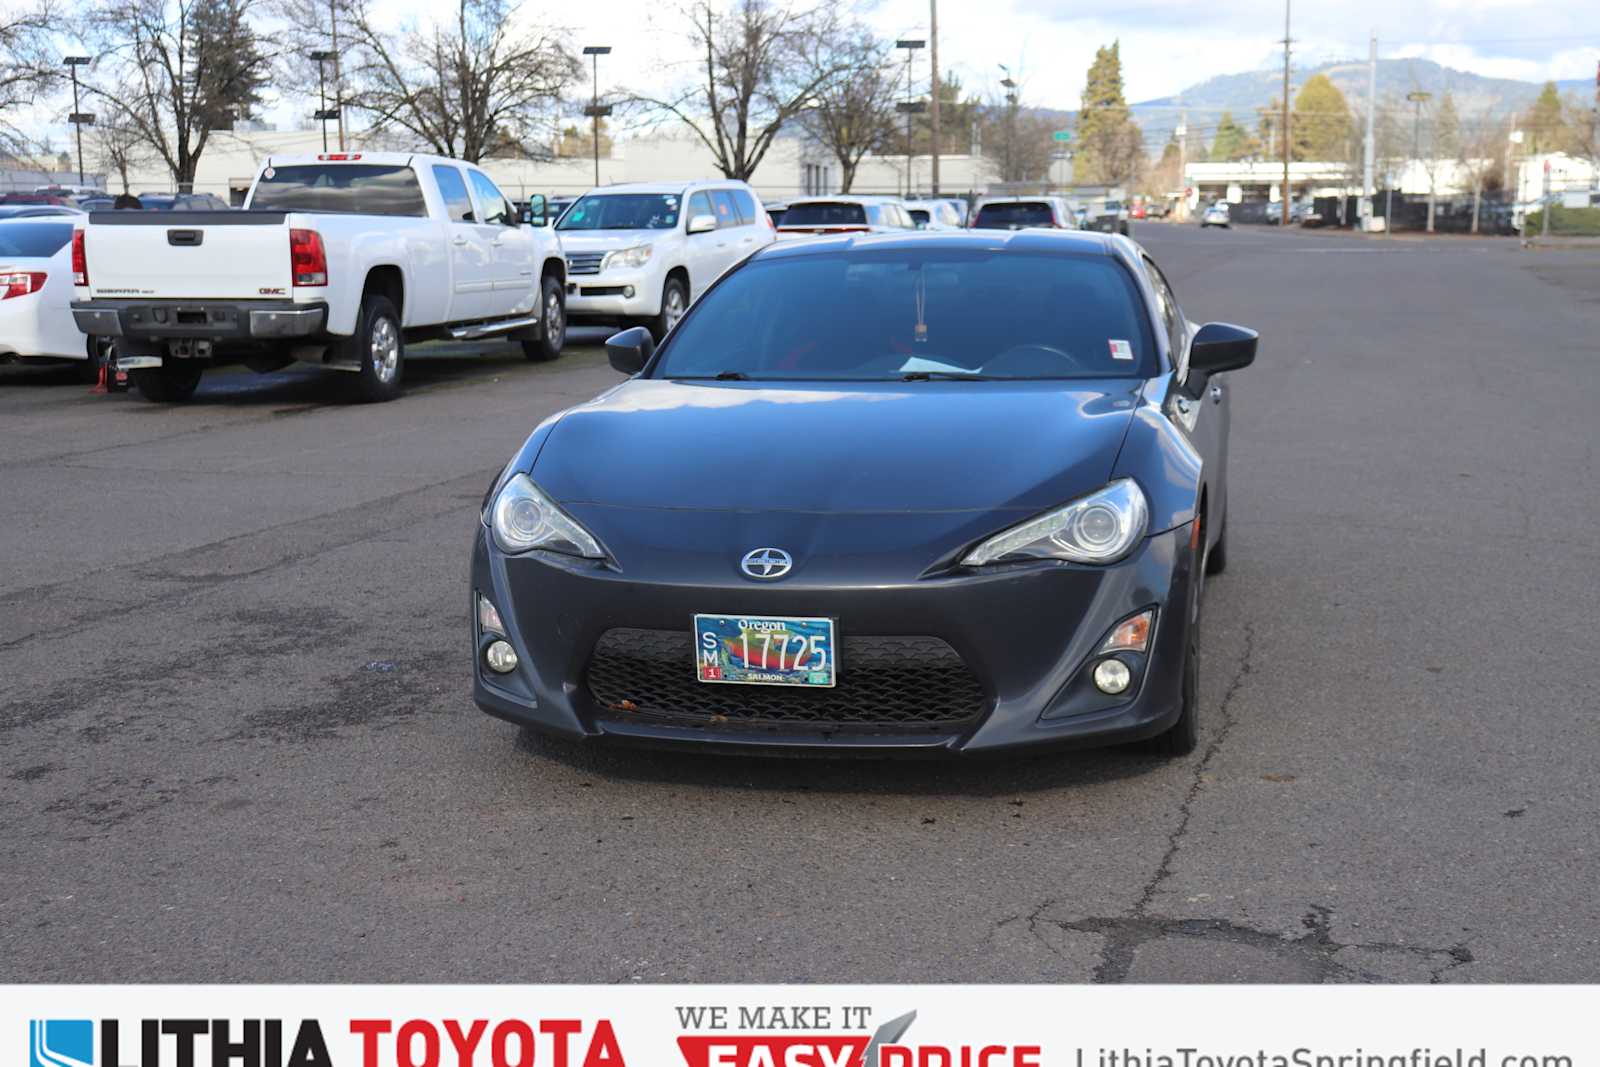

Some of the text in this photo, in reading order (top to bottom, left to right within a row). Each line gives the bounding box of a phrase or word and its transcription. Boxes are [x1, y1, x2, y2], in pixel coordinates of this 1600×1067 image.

[738, 618, 786, 633] Oregon
[739, 632, 826, 672] 17725
[747, 673, 783, 682] SALMON
